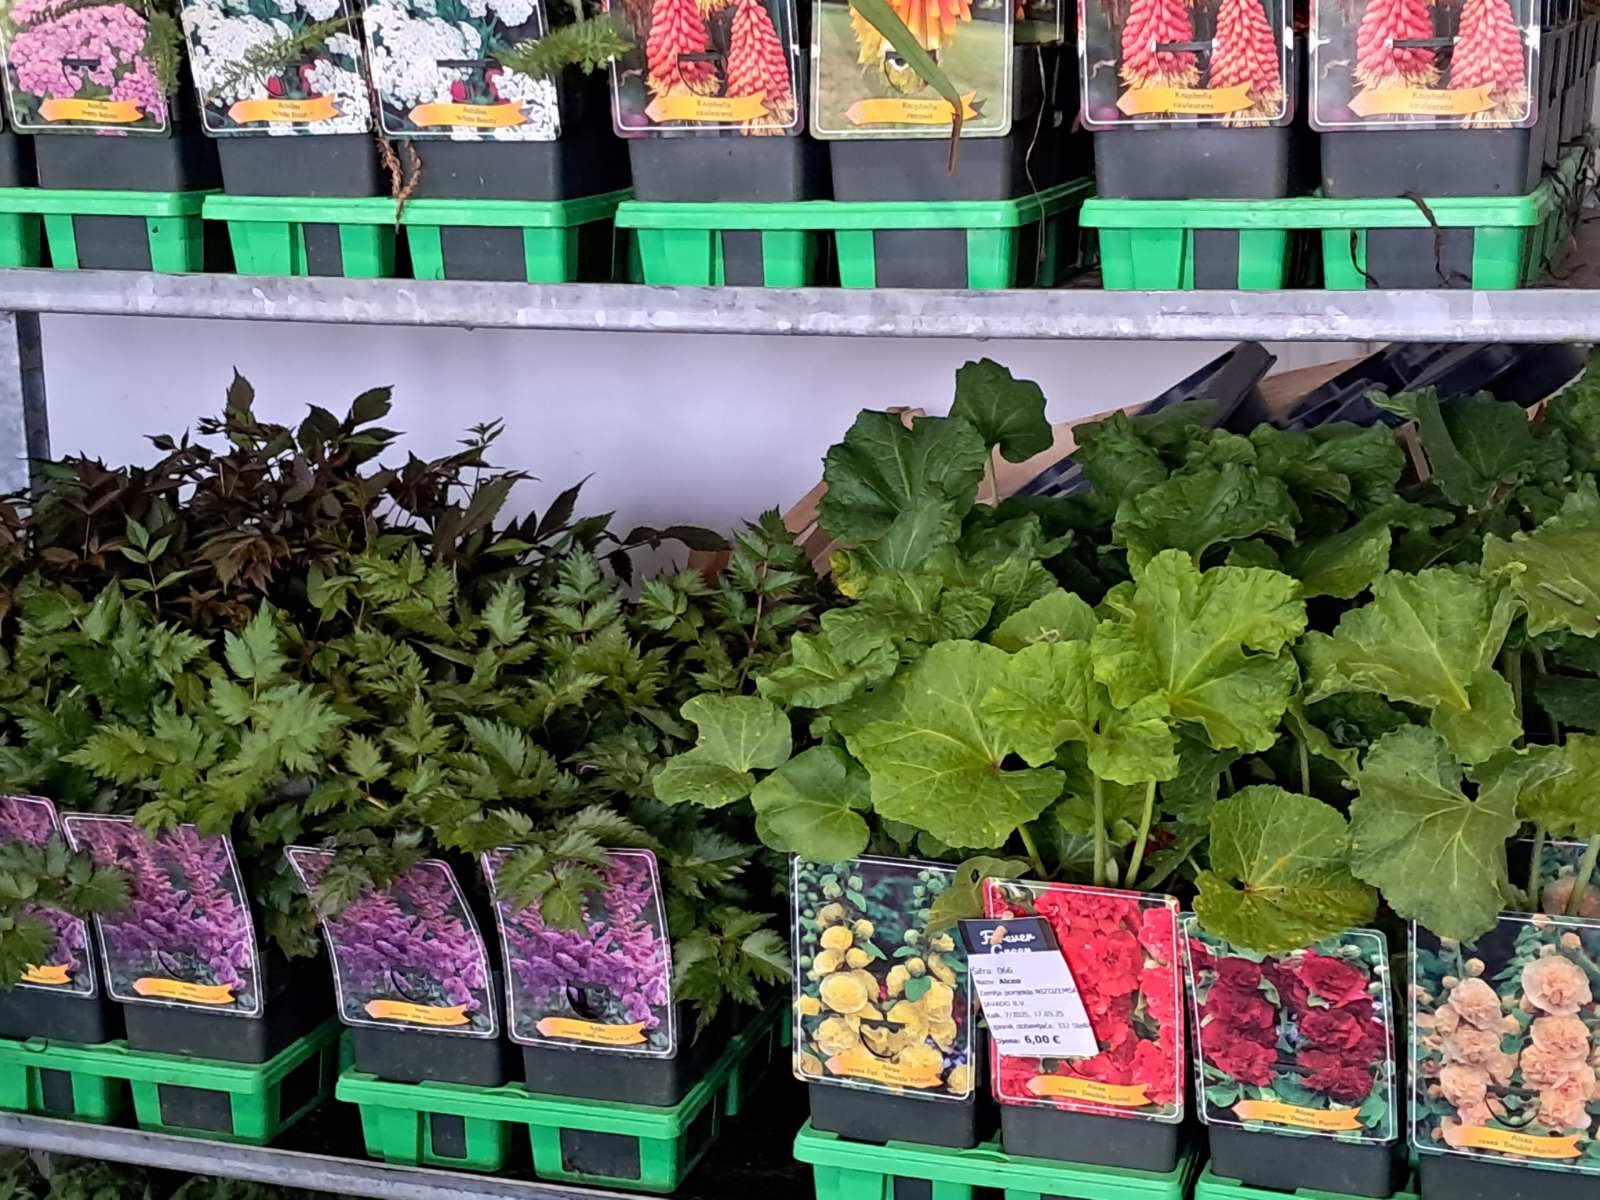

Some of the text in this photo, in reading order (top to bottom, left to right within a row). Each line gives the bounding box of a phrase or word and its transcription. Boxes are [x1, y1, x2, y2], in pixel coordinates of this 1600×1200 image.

[979, 929, 1036, 945] Fever
[1024, 1034, 1050, 1045] 6,00
[1053, 1035, 1062, 1044] €
